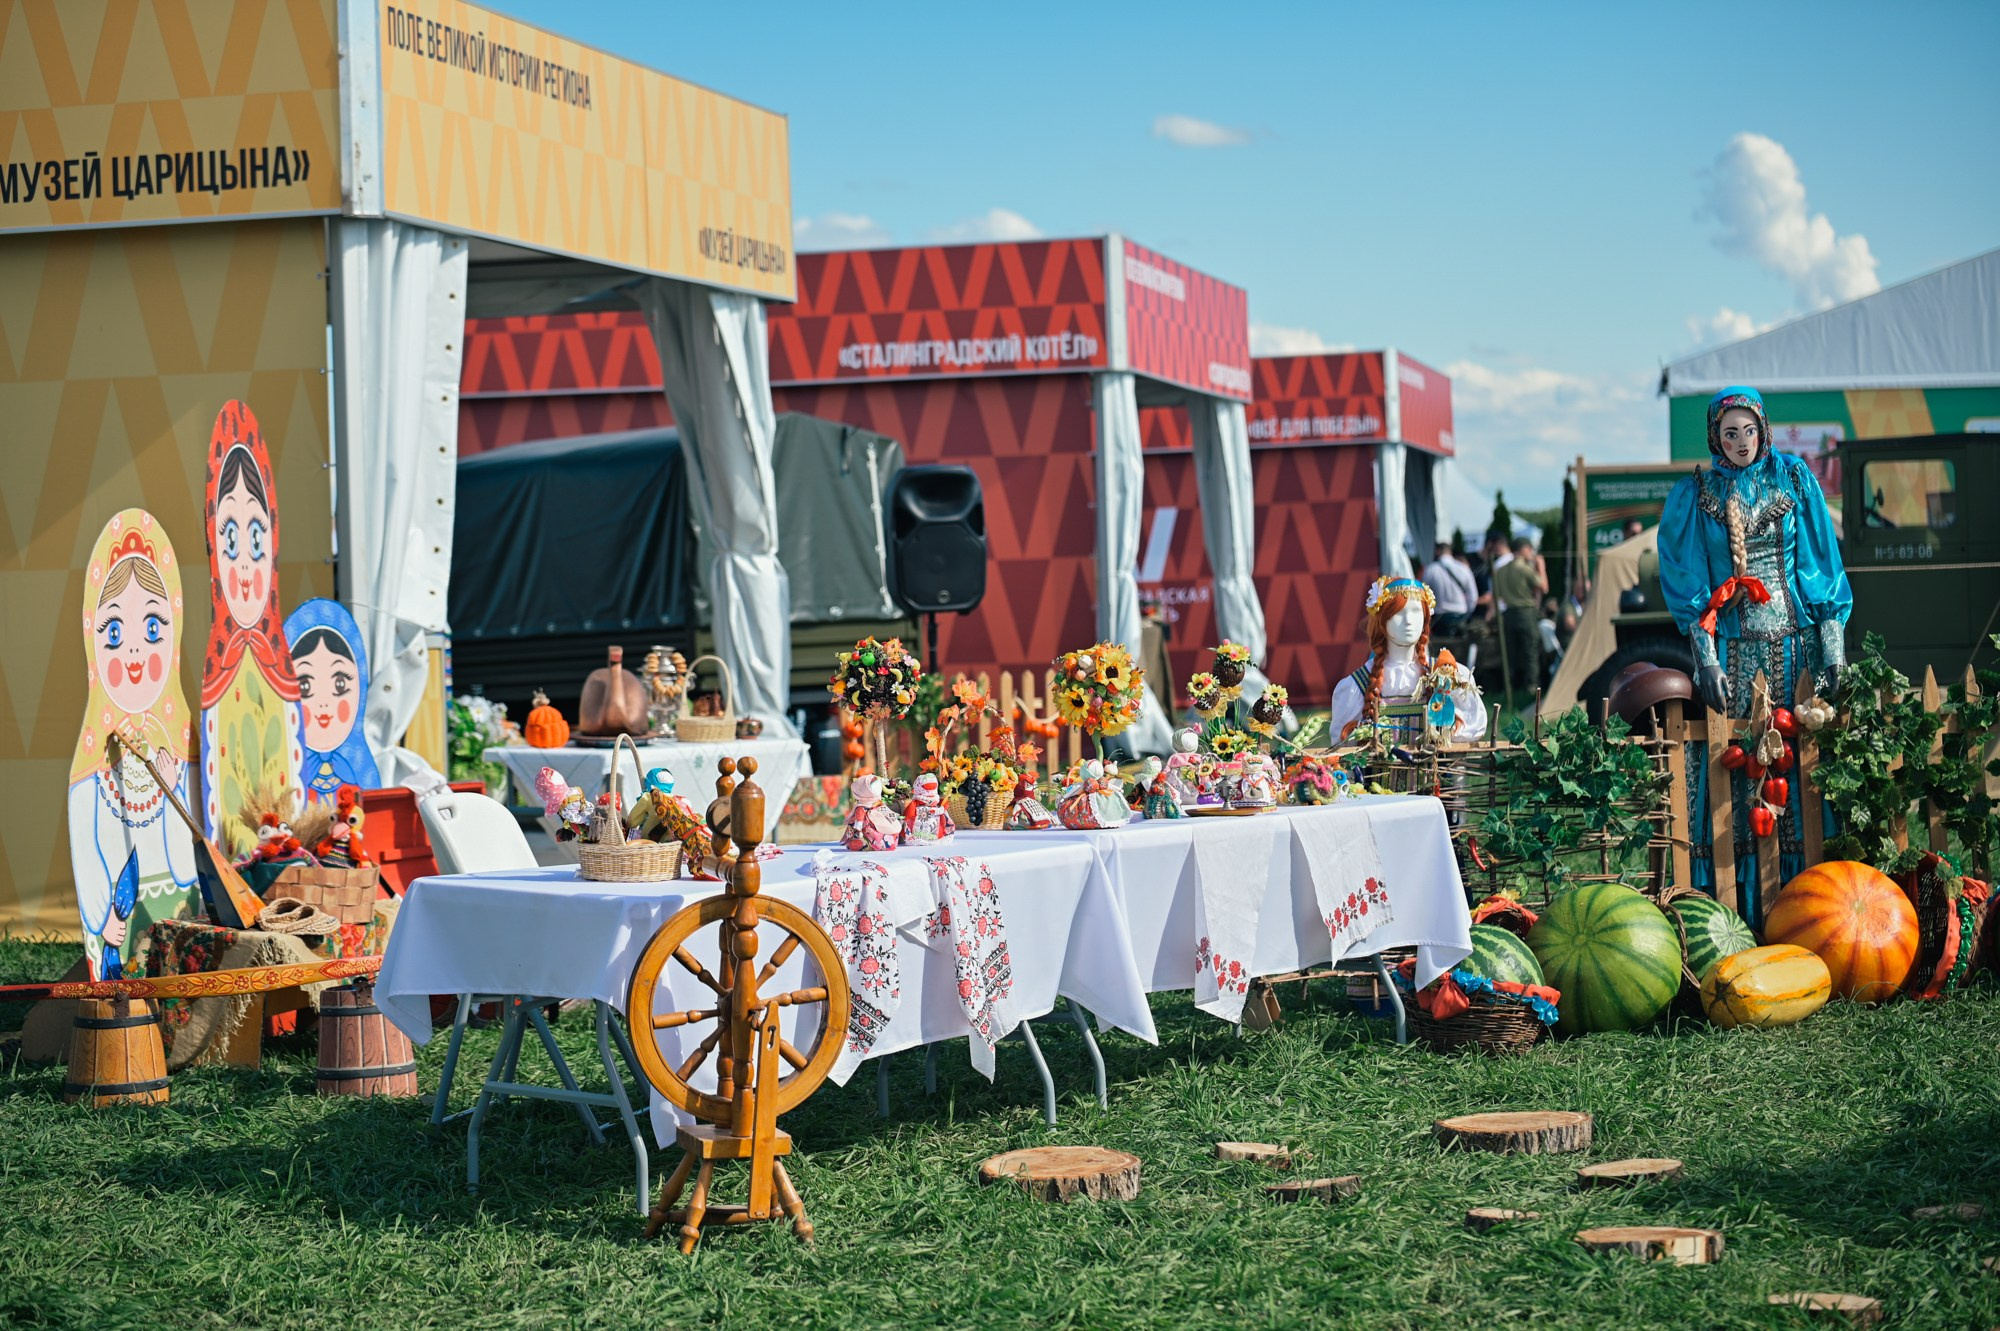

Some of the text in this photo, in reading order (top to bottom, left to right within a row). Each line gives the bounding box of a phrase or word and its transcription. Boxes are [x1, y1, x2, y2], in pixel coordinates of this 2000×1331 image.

[387, 6, 592, 111] ПОЛЕ ВЕЛИКОЙ ИСТОРИИ РЕГИОНА
[0, 146, 310, 204] МУЗЕЙ ЦАРИЦЫНА»
[839, 331, 1098, 369] «СТАЛИНГРАДСКИЙ КОТЁЛ»
